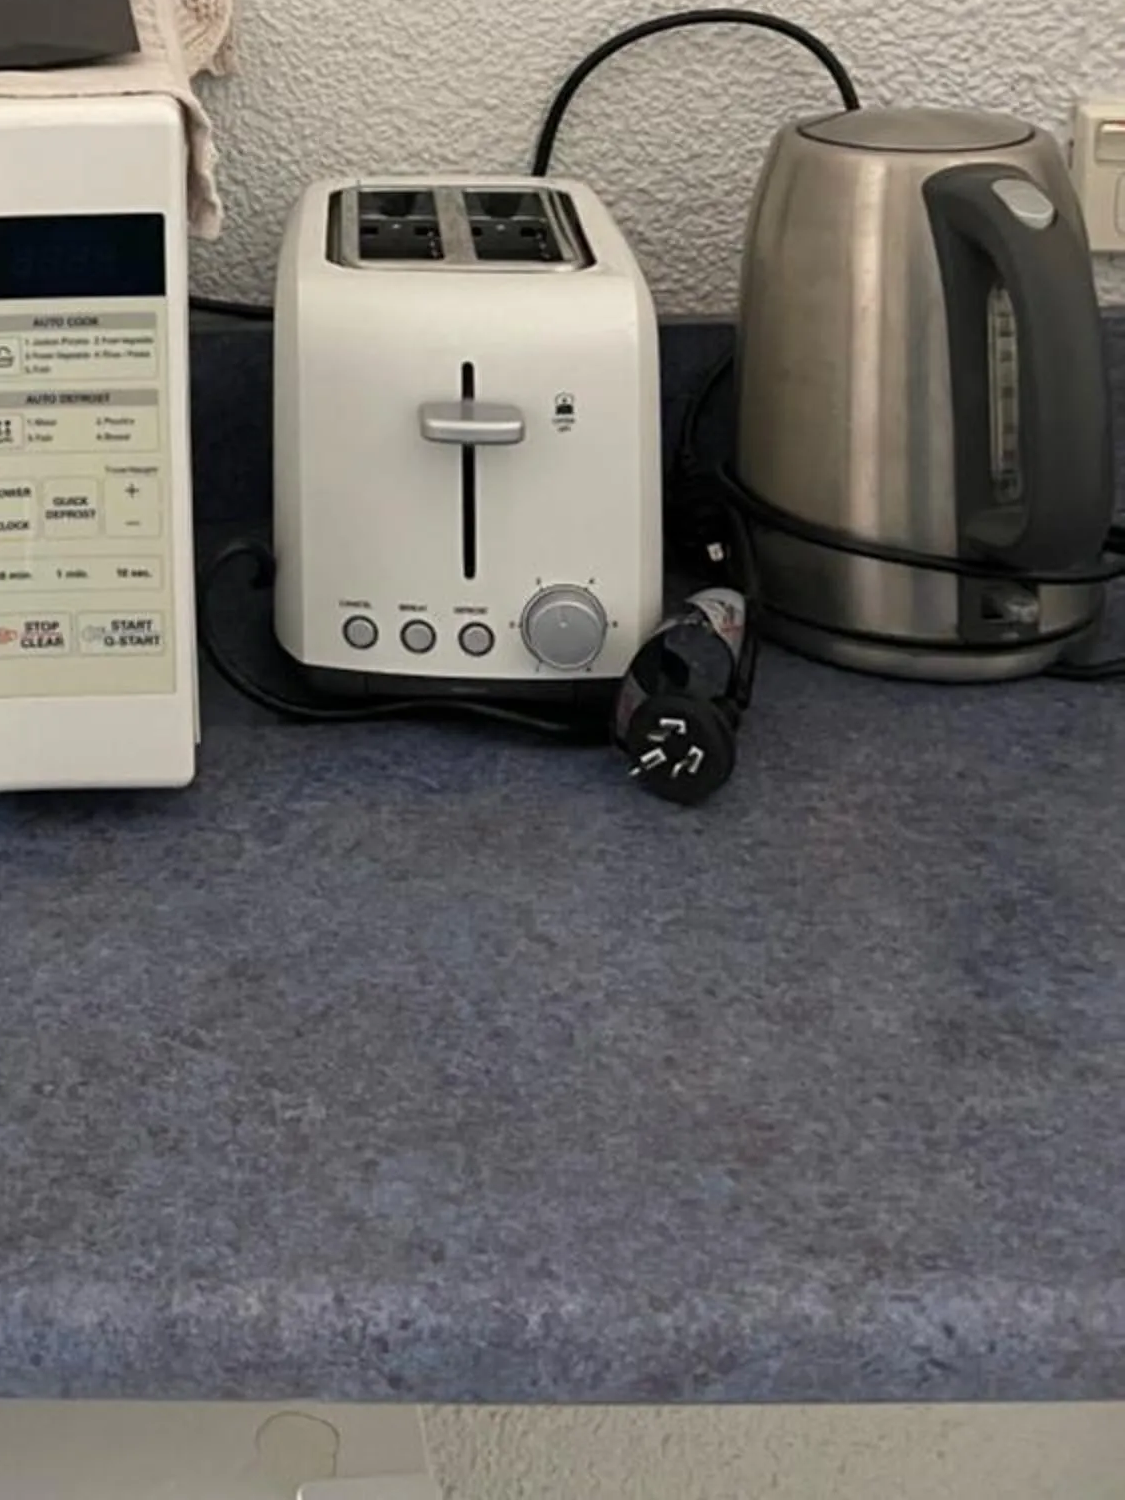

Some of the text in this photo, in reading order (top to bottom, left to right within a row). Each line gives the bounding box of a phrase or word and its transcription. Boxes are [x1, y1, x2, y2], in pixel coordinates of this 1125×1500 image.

[32, 315, 100, 328] AUTO COOK
[26, 392, 110, 405] AUTO DEFROST
[52, 496, 89, 507] QUICK
[45, 509, 97, 520] DEFROST
[24, 620, 60, 632] STOP
[110, 619, 154, 631] START
[20, 635, 65, 649] CLEAR
